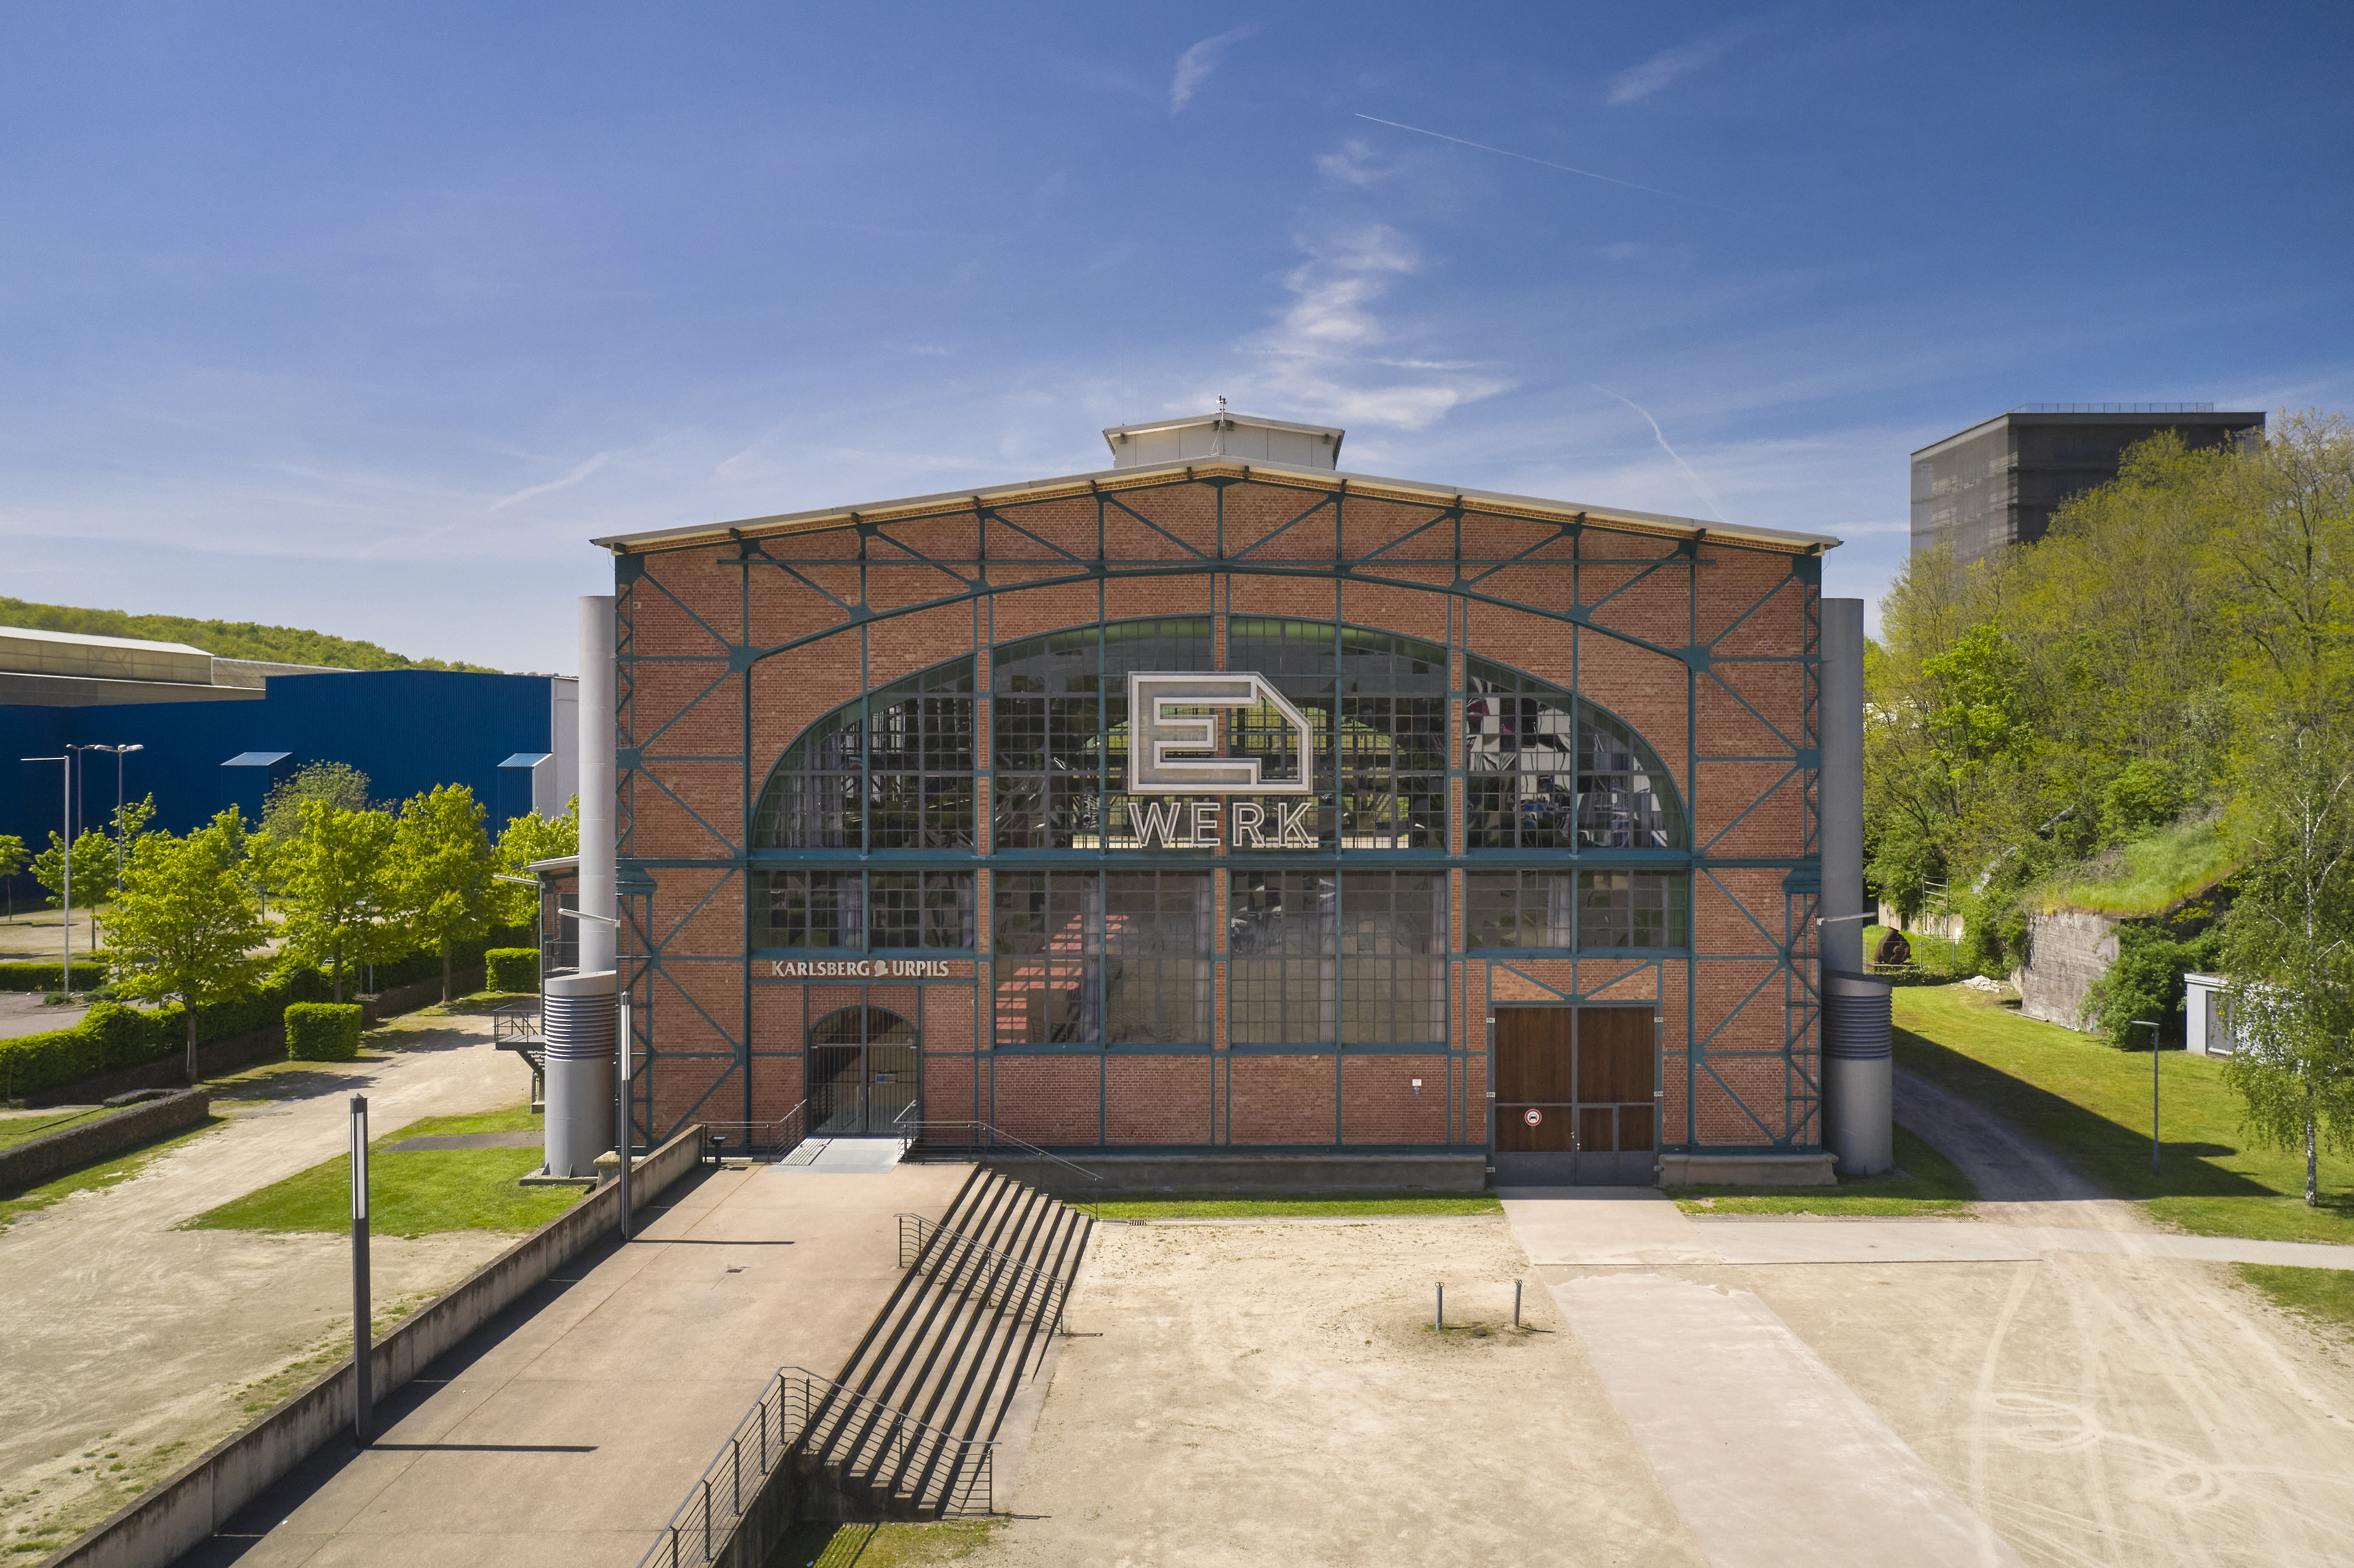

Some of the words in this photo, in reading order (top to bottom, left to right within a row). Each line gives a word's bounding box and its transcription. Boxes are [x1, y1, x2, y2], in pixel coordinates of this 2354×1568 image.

[1128, 802, 1312, 847] WERK
[772, 960, 870, 977] KARLSBERG
[892, 960, 949, 977] URPILS
